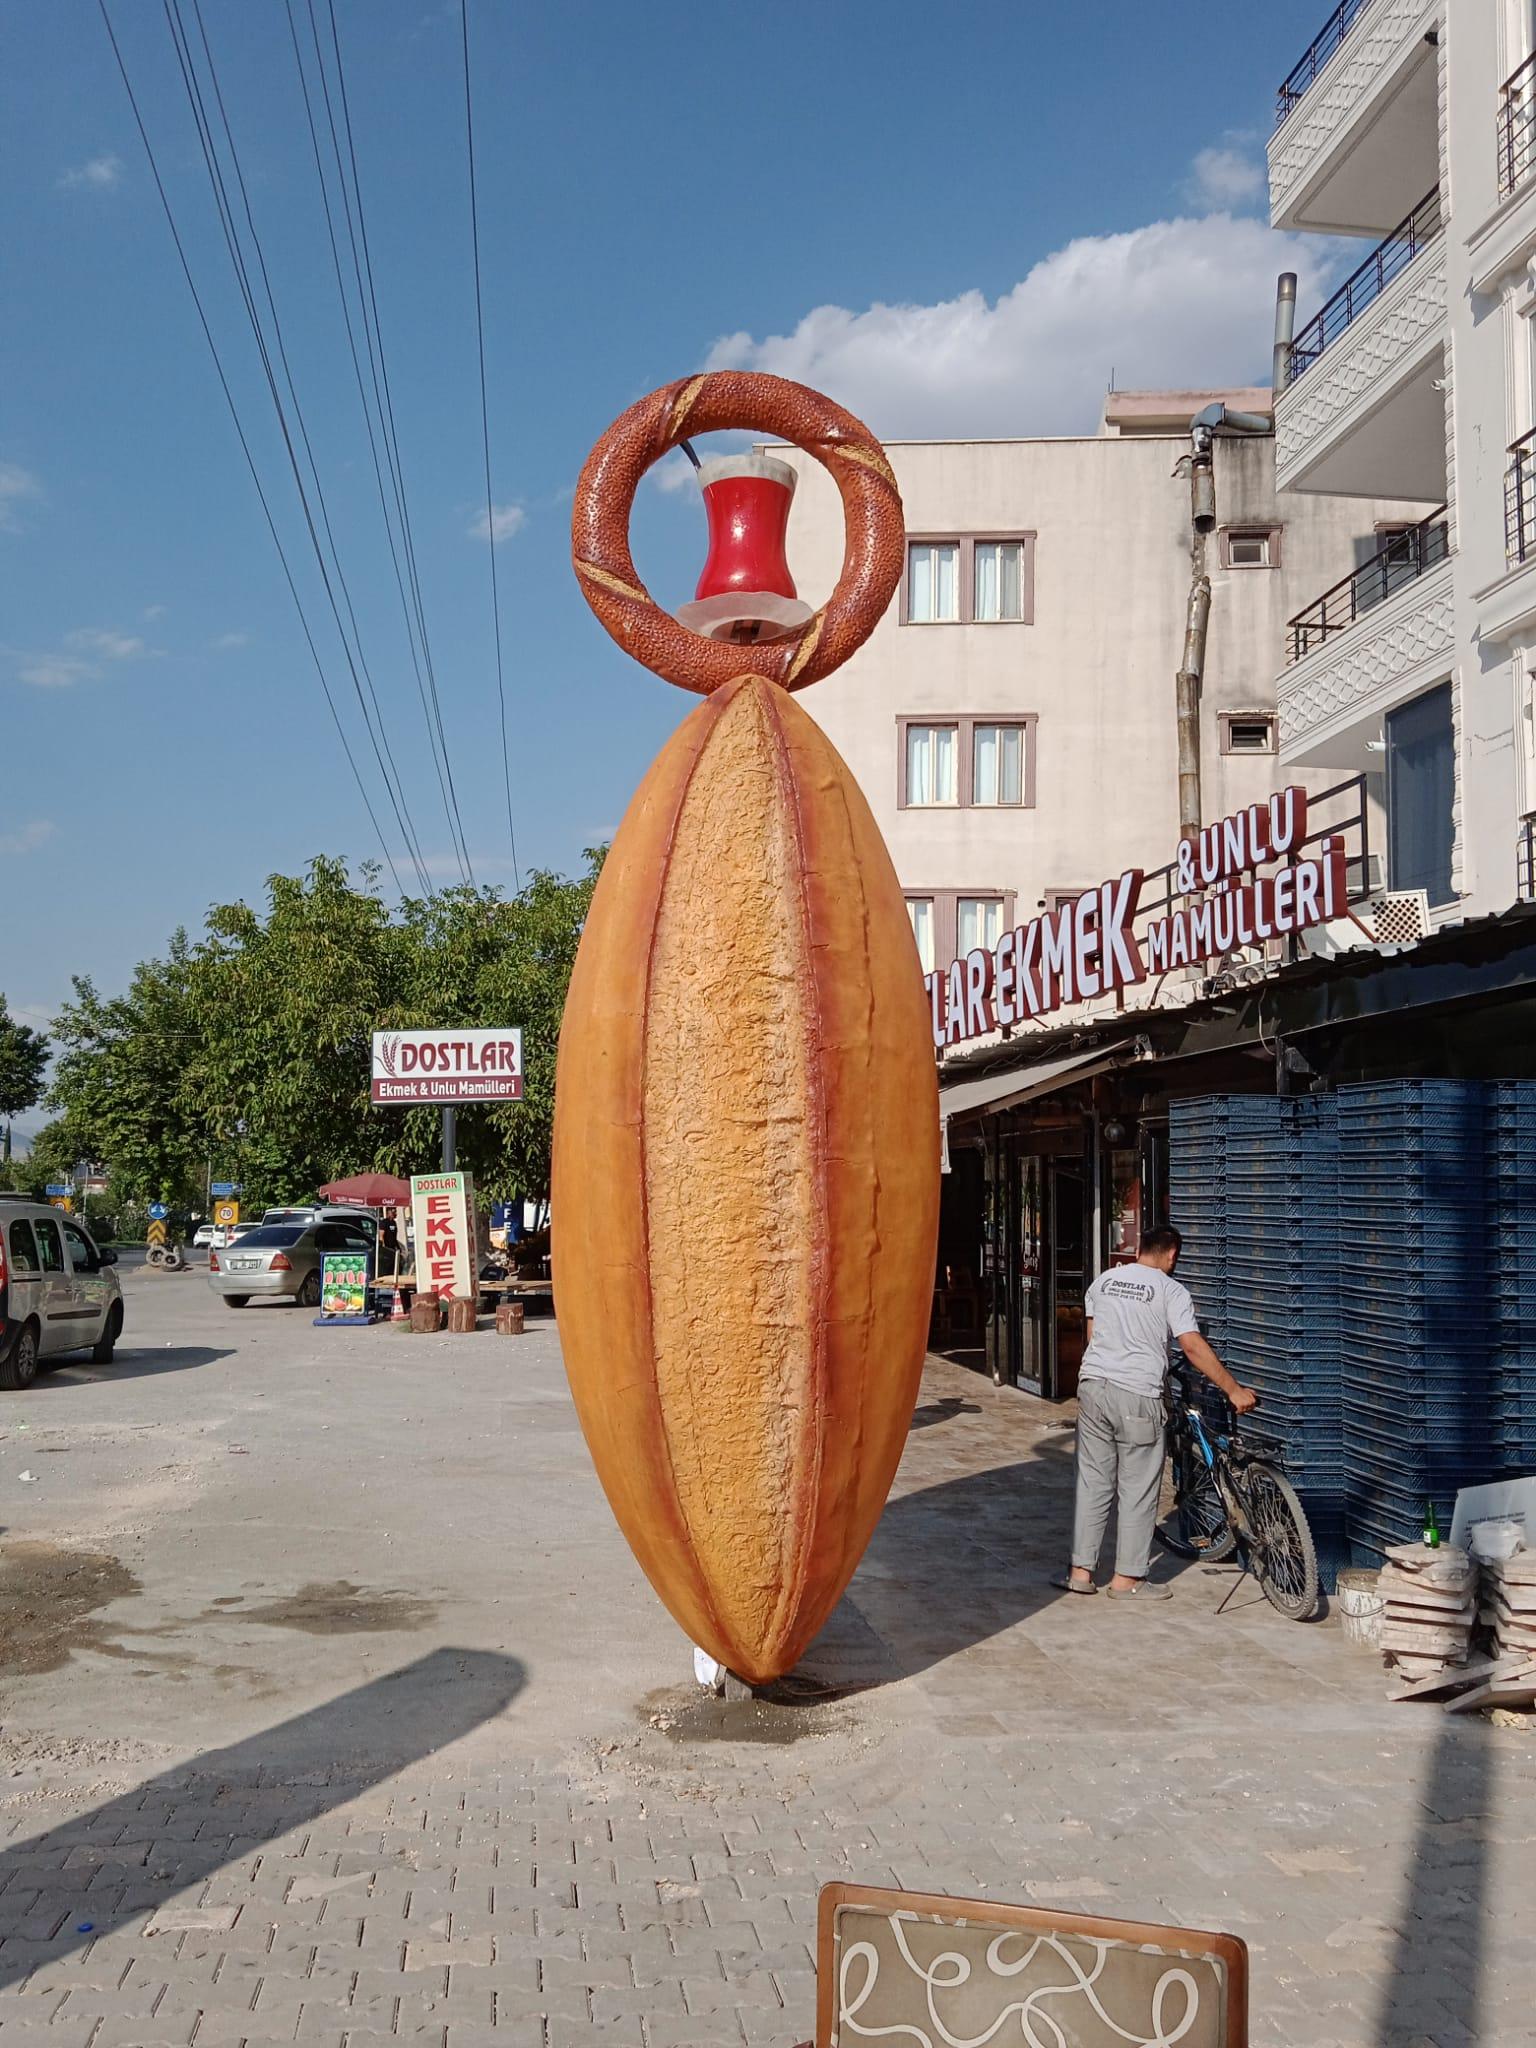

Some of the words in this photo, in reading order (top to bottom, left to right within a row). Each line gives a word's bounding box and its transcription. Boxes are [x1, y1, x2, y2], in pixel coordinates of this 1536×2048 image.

[1177, 838, 1196, 894] &
[1200, 787, 1294, 884] UNLU
[1148, 837, 1333, 974] MAMÜLLERİ
[924, 948, 988, 1047] LAR
[996, 872, 1135, 1026] EKMEK
[401, 1041, 516, 1073] DOSTLAR
[379, 1082, 418, 1097] Ekmek
[419, 1082, 428, 1096] &
[430, 1081, 457, 1096] Unlu
[459, 1079, 516, 1095] Mamülleri
[417, 1177, 458, 1191] DOSTLAR
[222, 1209, 232, 1217] 70
[425, 1195, 459, 1303] EKMEK
[1111, 1280, 1146, 1291] DOSTLAR
